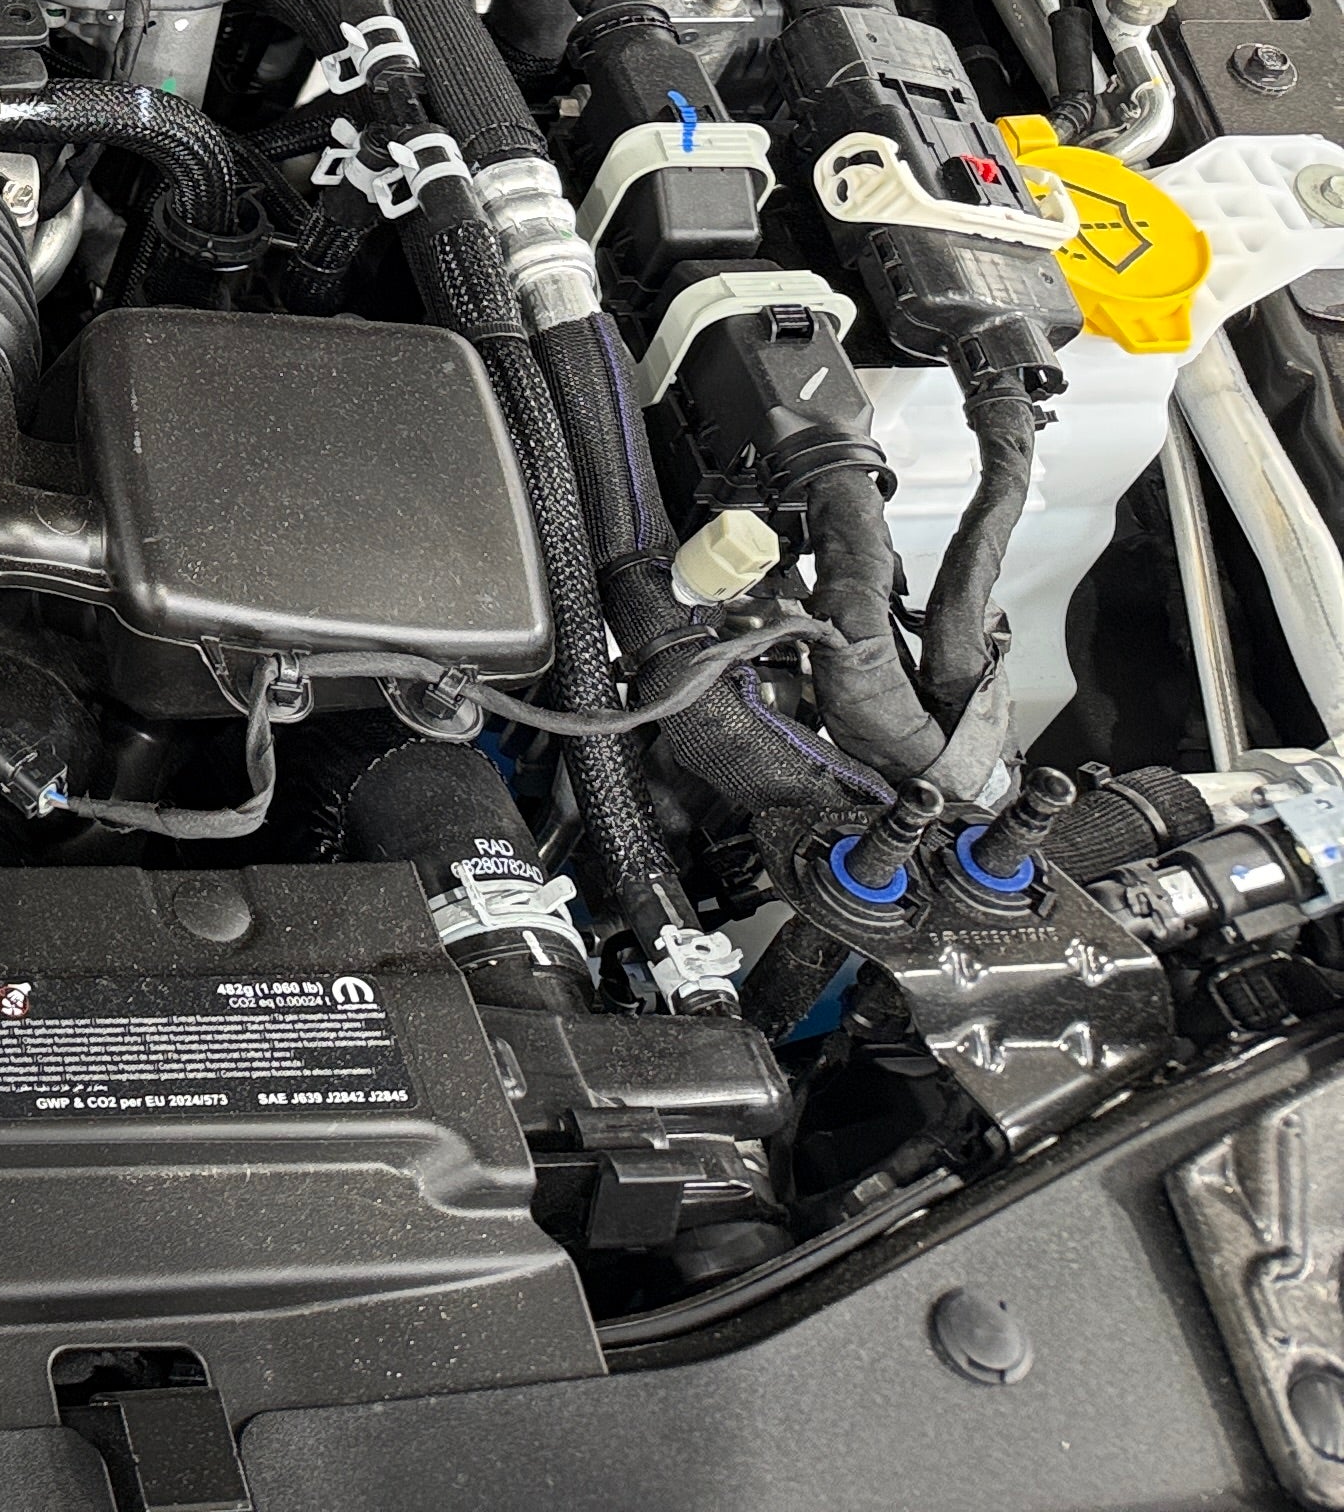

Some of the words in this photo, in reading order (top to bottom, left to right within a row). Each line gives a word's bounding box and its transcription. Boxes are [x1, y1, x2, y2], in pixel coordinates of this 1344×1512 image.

[474, 838, 514, 856] RAD
[217, 983, 254, 997] 482g
[255, 982, 300, 996] (1.060
[229, 997, 257, 1008] CO2
[259, 998, 275, 1009] eq
[276, 996, 323, 1007] 0.00024
[36, 1097, 69, 1109] GWP
[73, 1097, 84, 1108] &
[87, 1096, 117, 1108] CO2
[120, 1097, 142, 1110] per
[145, 1095, 165, 1106] EU
[258, 1093, 288, 1105] SAE
[291, 1092, 323, 1104] J639
